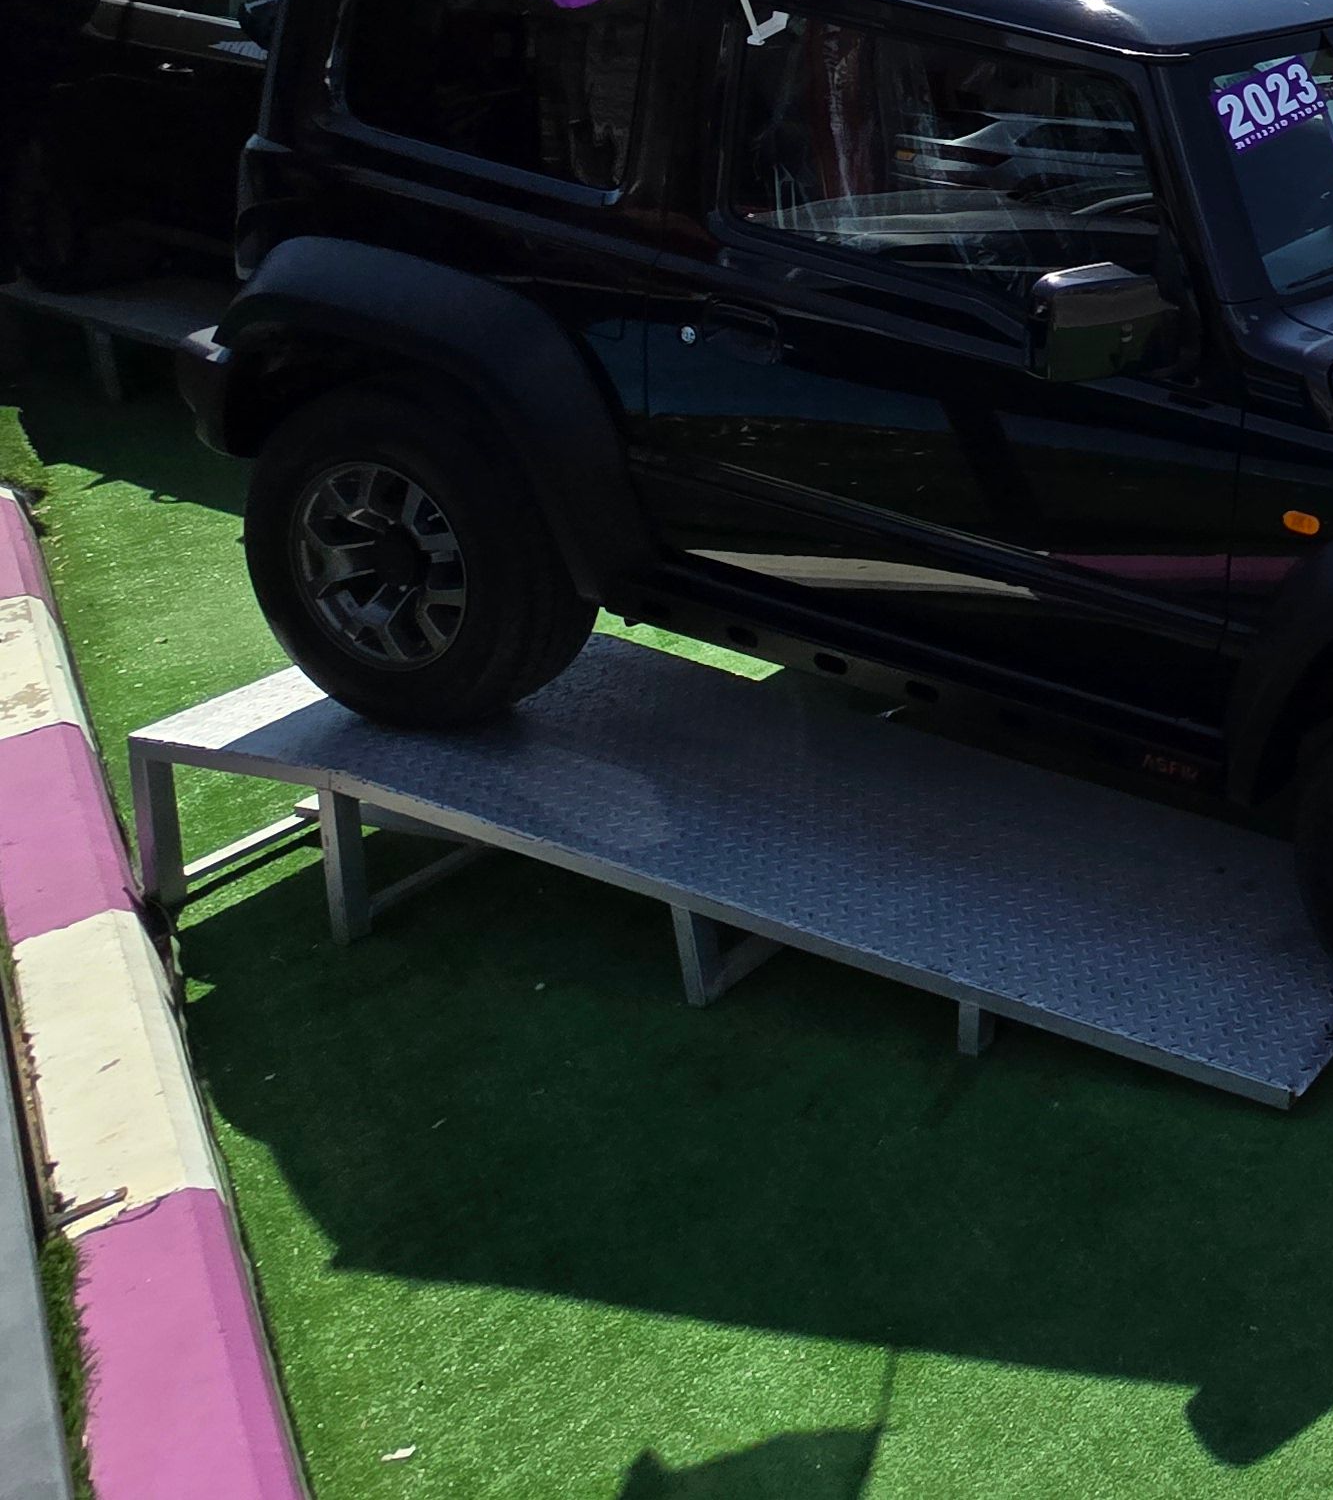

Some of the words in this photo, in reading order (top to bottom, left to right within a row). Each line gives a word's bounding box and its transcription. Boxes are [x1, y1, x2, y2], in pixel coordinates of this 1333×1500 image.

[1217, 64, 1318, 140] 2023
[1290, 100, 1325, 122] סנטרל
[1234, 118, 1290, 151] סוכנויות
